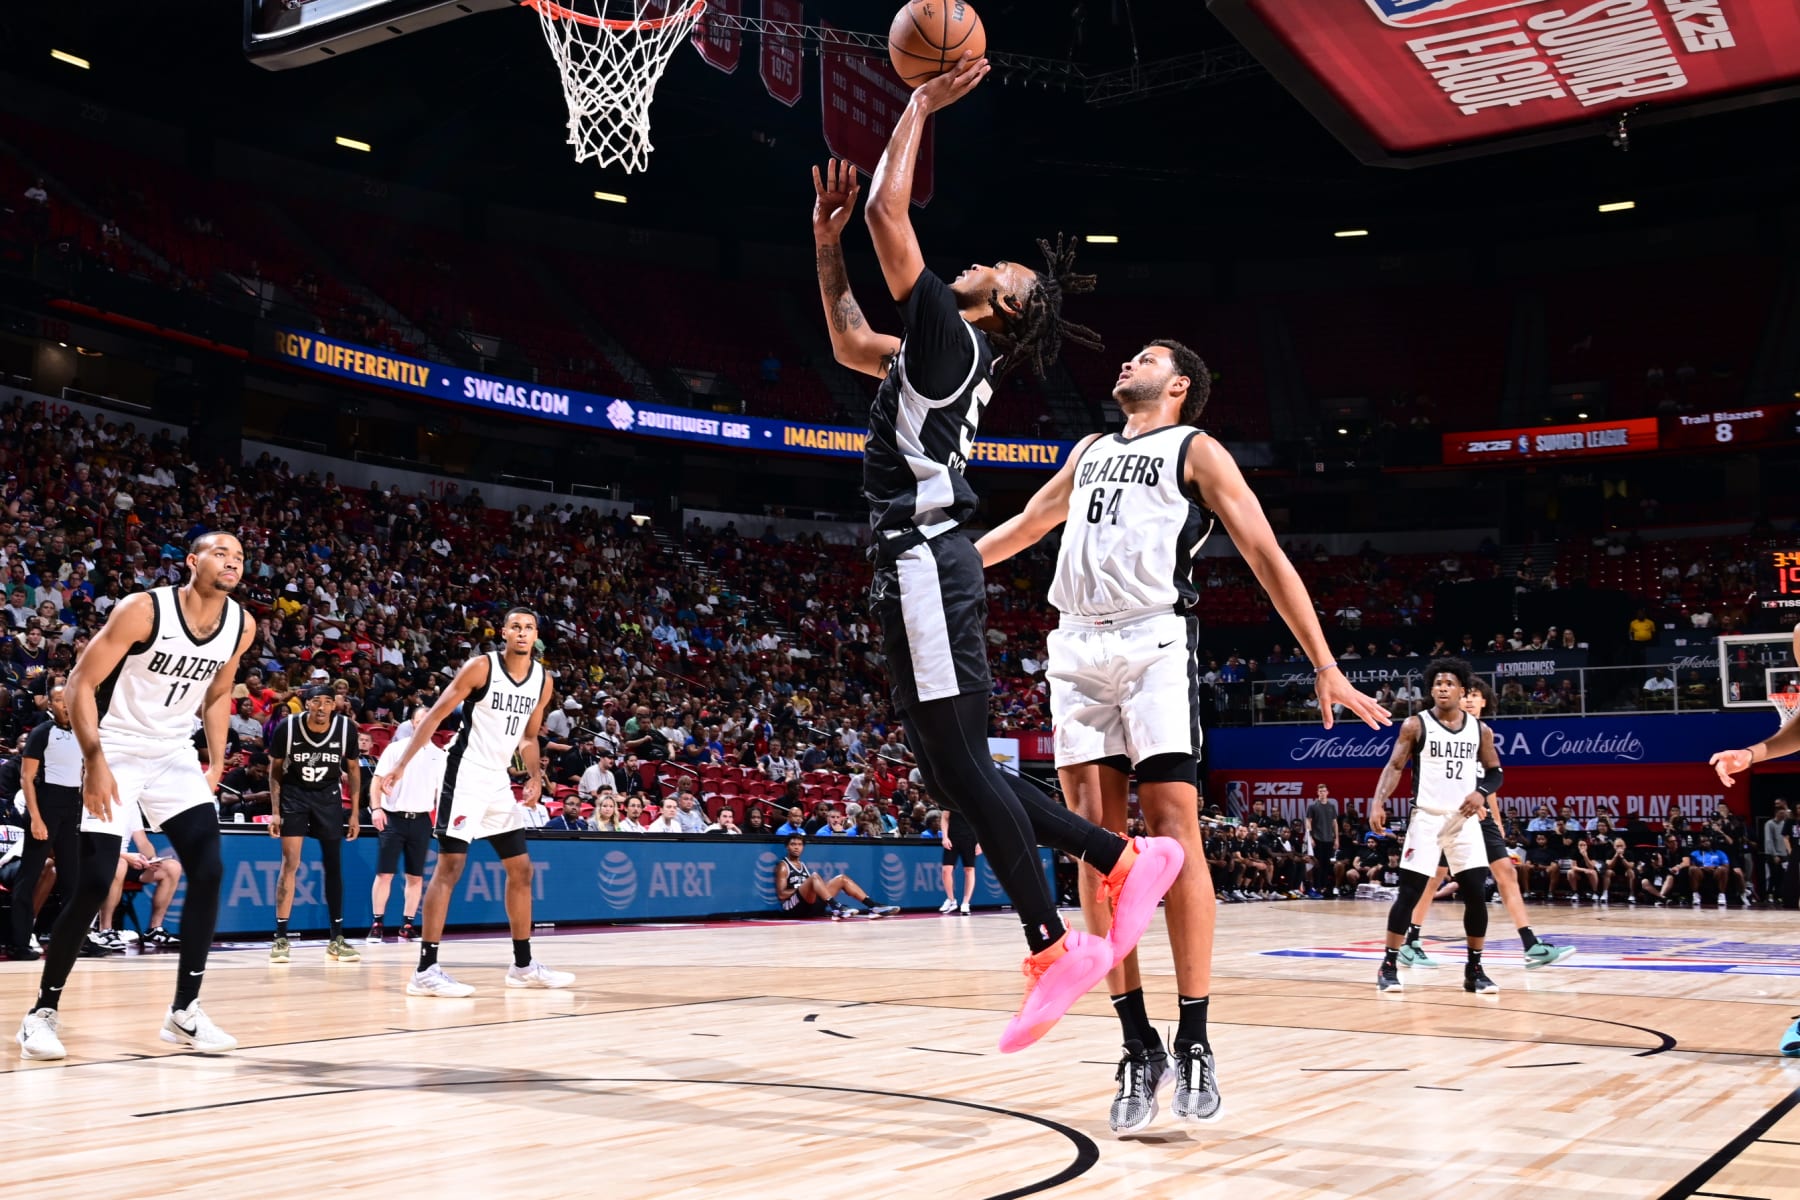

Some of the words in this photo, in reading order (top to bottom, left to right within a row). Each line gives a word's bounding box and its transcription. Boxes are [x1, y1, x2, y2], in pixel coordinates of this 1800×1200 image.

[1405, 19, 1567, 116] LEAGUE
[1527, 0, 1688, 107] SUMMER
[771, 55, 793, 86] 1975
[314, 340, 430, 388] DIFFERENTLY
[463, 376, 569, 416] SWGAS.COM
[637, 411, 719, 436] SOUTHWEST
[722, 421, 751, 440] GAS
[1680, 413, 1710, 426] Trail
[1713, 409, 1764, 423] Blazers
[1467, 440, 1513, 453] 2K25
[1535, 432, 1584, 452] SUMMER
[1587, 428, 1628, 448] LEAGUE
[1715, 424, 1733, 442] 8
[1080, 454, 1164, 487] BLAZERS
[1087, 488, 1124, 525] 64
[164, 681, 191, 707] 11
[505, 715, 520, 736] 10
[1291, 737, 1392, 761] Michelob
[1541, 731, 1644, 761] Courtside
[302, 766, 328, 782] 97
[1446, 760, 1464, 780] 52
[1253, 782, 1304, 795] 2K25
[1626, 795, 1672, 822] PLAY
[648, 862, 716, 898] AT&T
